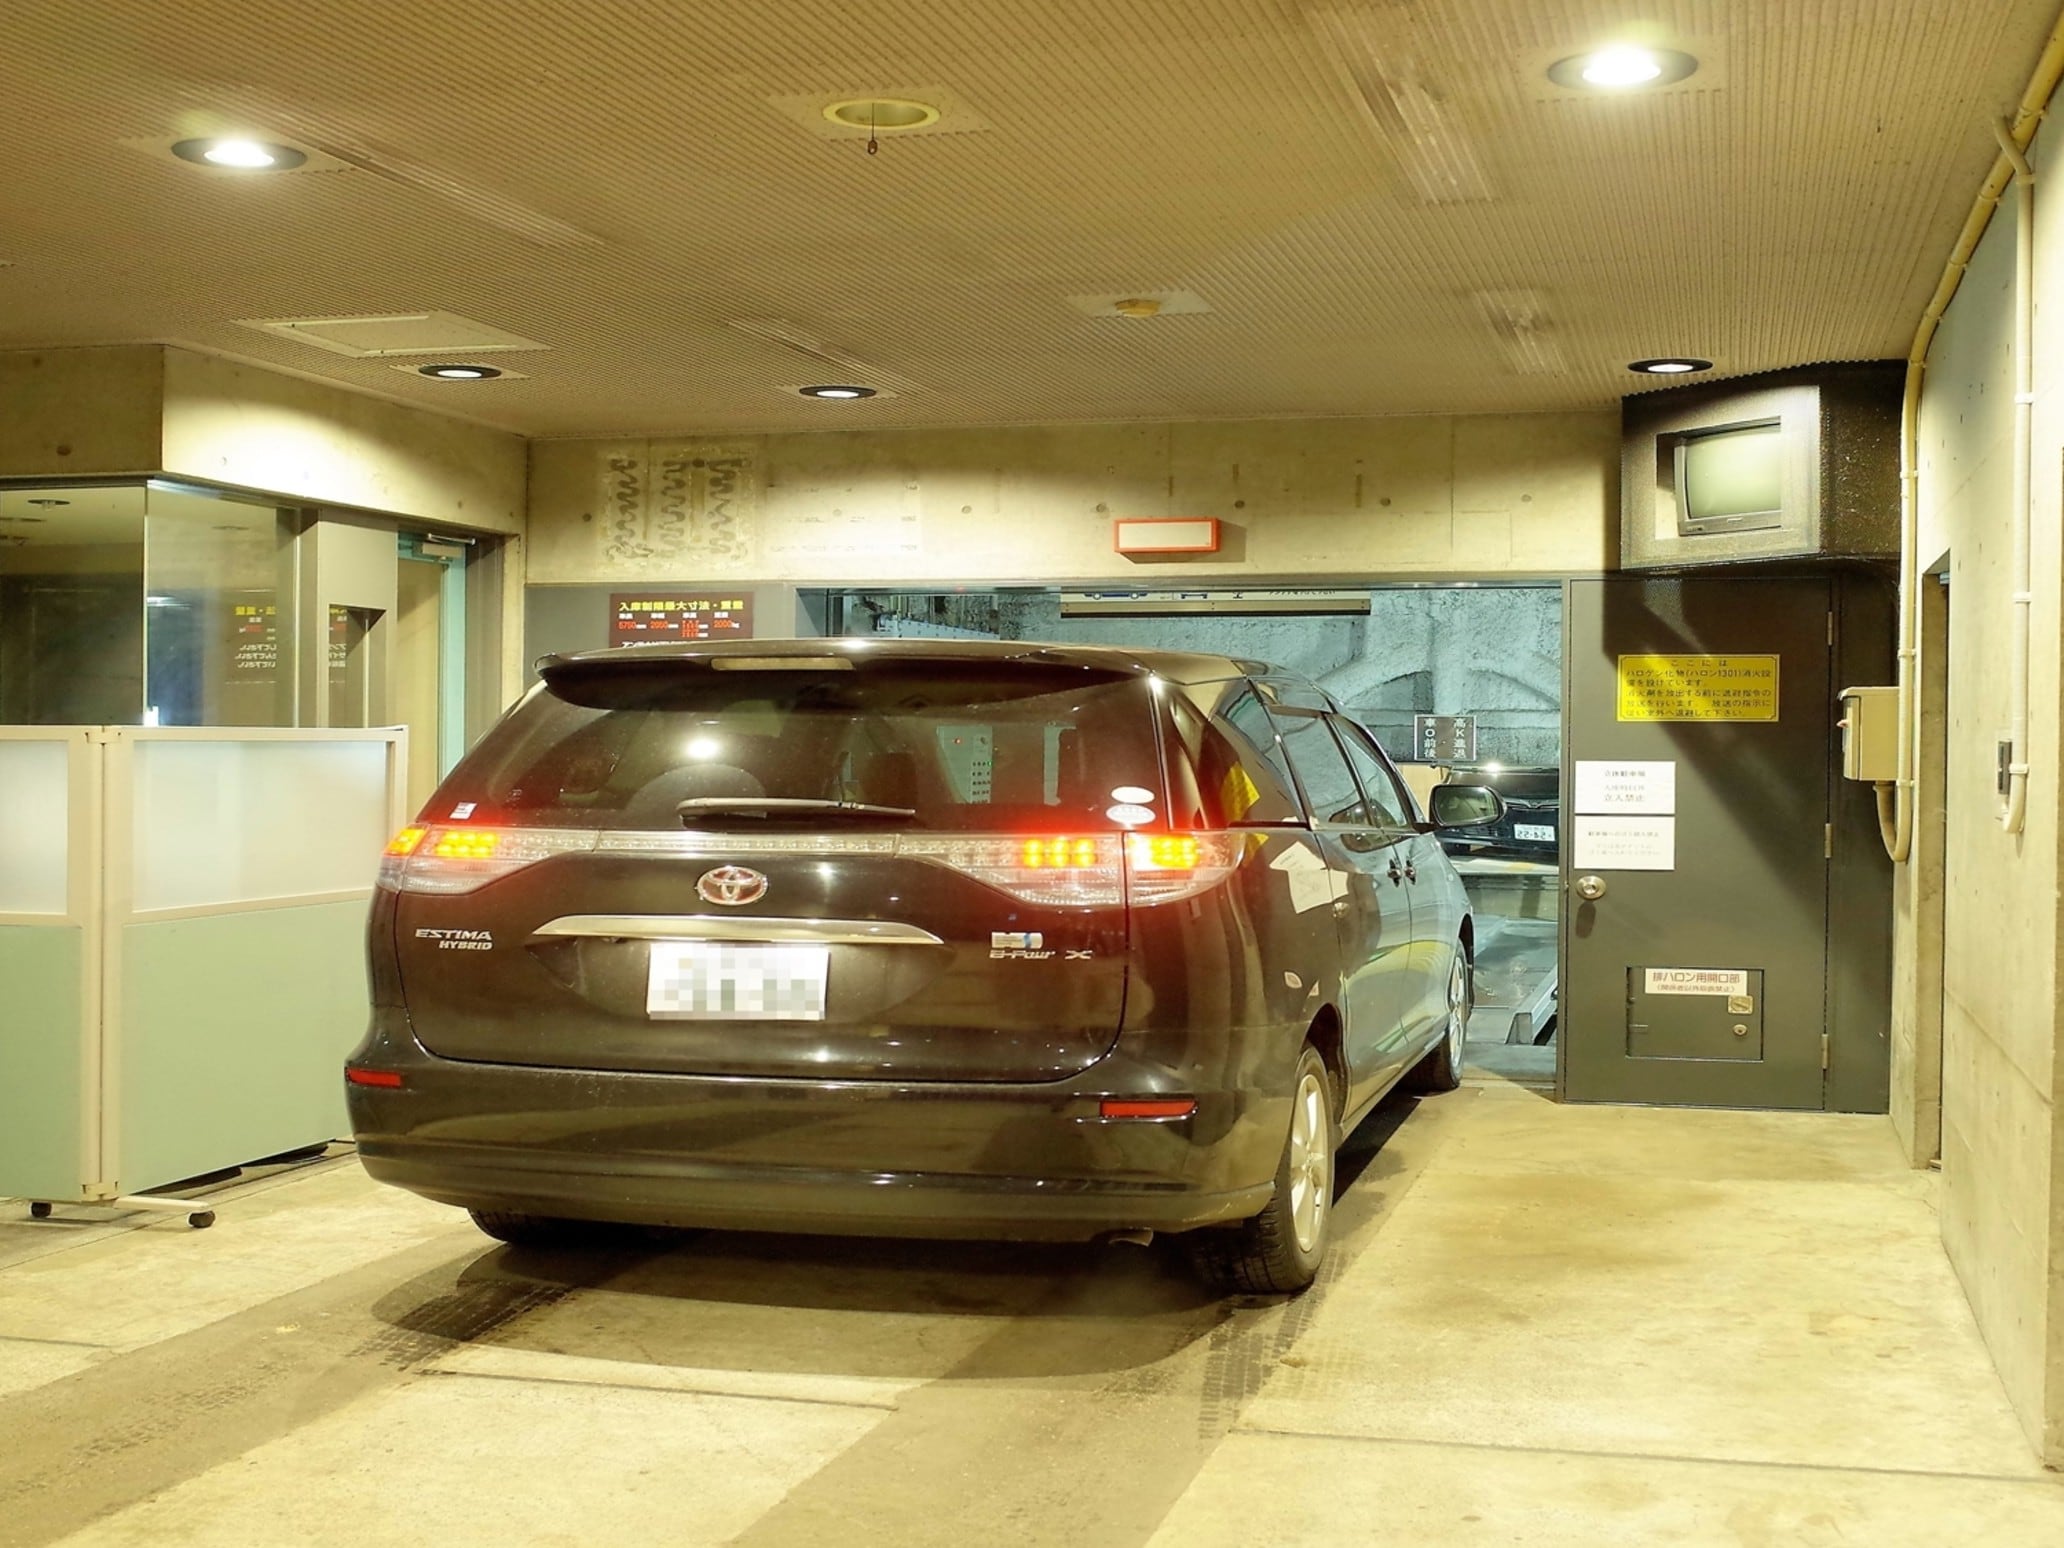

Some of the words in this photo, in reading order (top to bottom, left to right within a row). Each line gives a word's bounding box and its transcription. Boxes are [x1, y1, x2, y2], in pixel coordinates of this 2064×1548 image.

[415, 929, 493, 941] ESTIMA
[438, 939, 493, 951] HYBRID
[1064, 950, 1093, 959] X
[1652, 971, 1741, 984] 排ハロン用開口部
